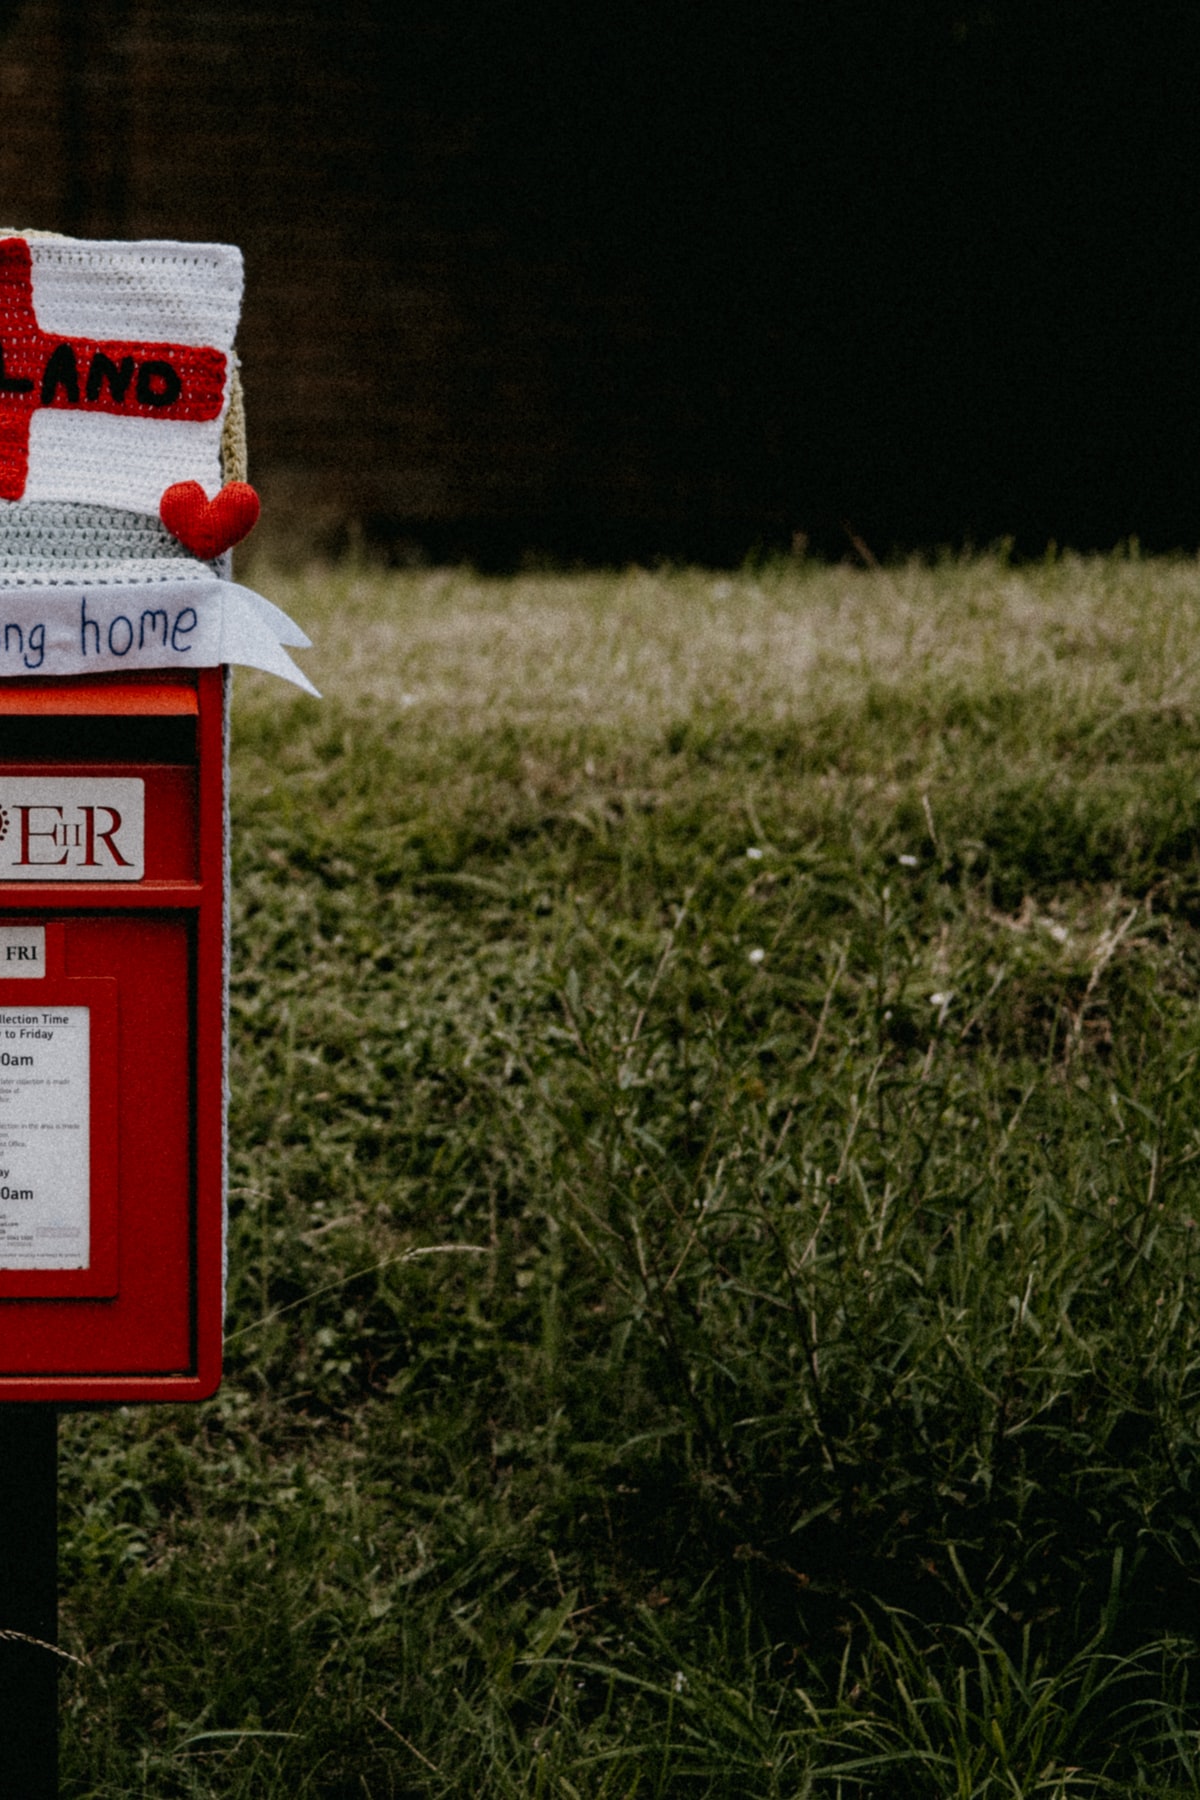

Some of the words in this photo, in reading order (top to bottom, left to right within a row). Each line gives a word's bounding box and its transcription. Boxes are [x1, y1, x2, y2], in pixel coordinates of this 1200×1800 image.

[80, 596, 198, 657] home
[5, 945, 38, 961] FRI
[42, 1014, 69, 1024] Time
[5, 1029, 16, 1040] to
[20, 1029, 54, 1040] Friday
